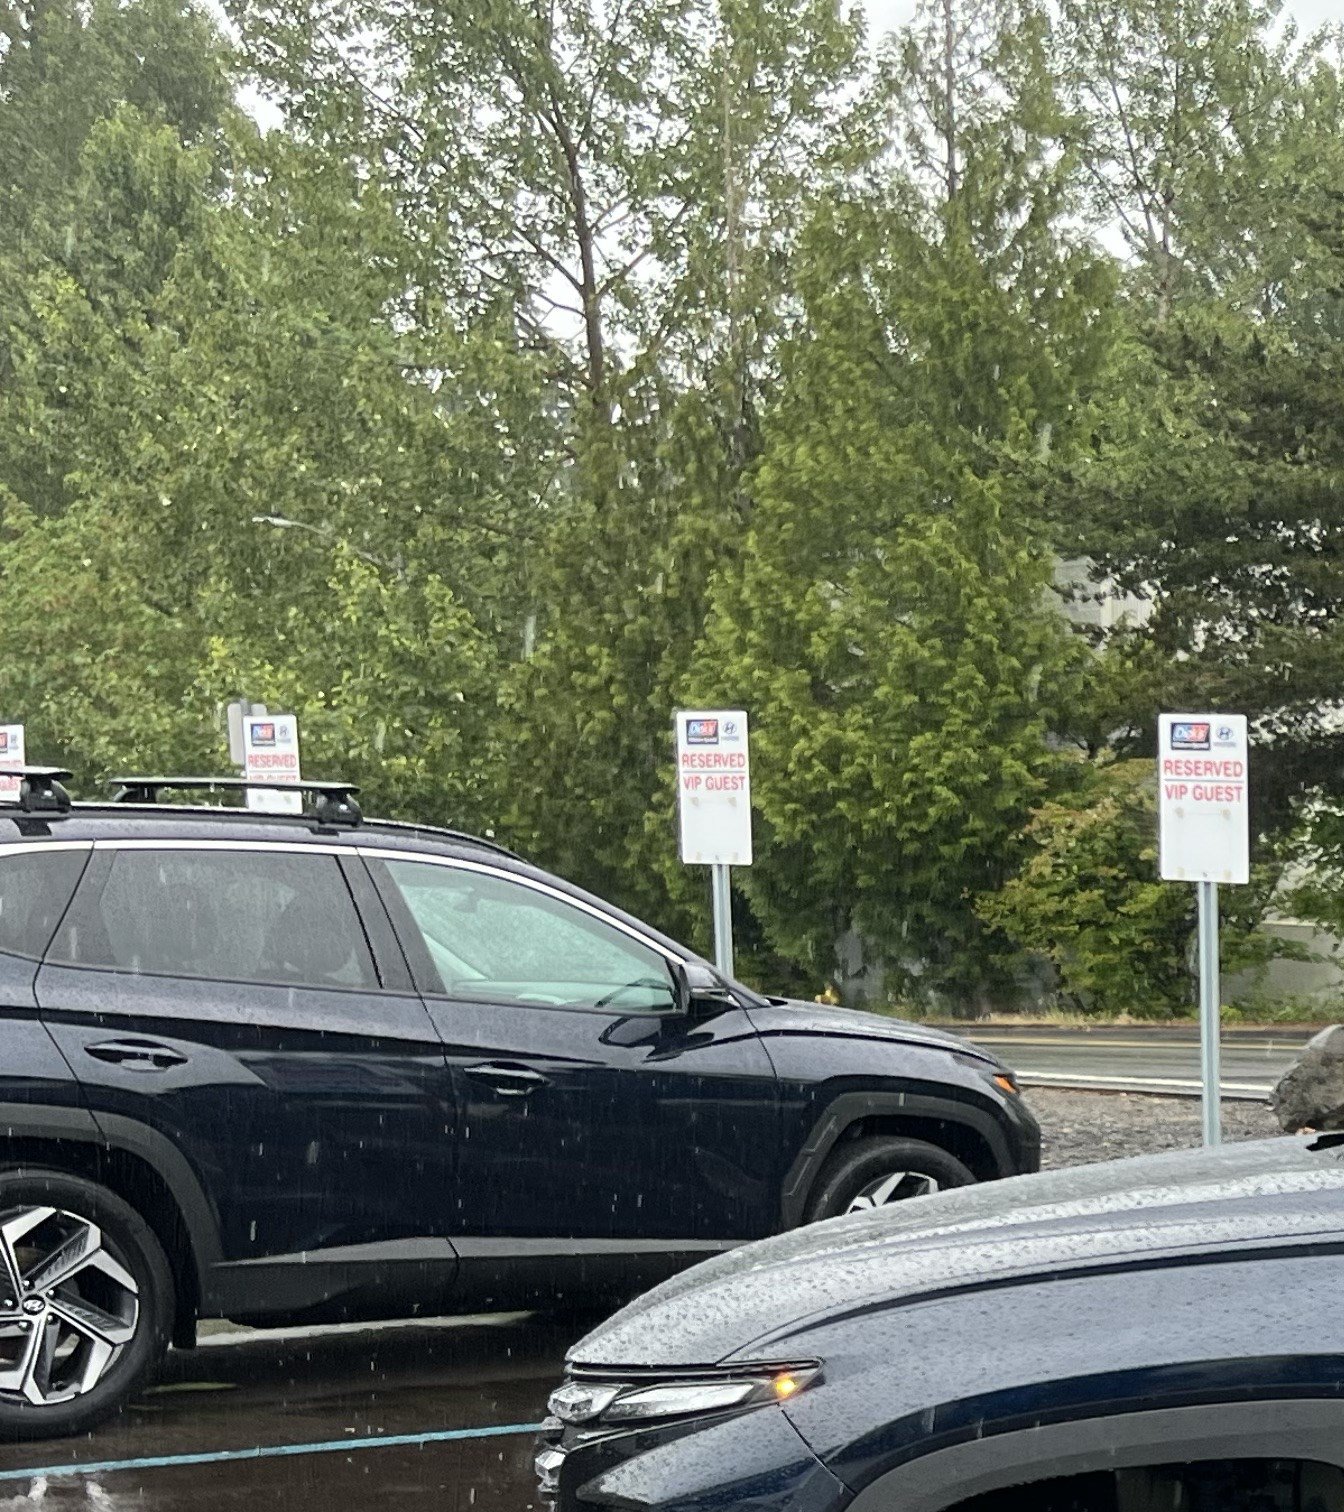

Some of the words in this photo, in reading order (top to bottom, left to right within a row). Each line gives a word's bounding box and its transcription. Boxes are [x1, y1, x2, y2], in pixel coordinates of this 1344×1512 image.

[682, 753, 746, 768] RESERVED
[1164, 760, 1243, 777] RESERVED
[683, 776, 702, 791] VIP
[705, 776, 745, 791] GUEST
[1165, 785, 1188, 801] VIP
[1193, 786, 1243, 802] GUEST
